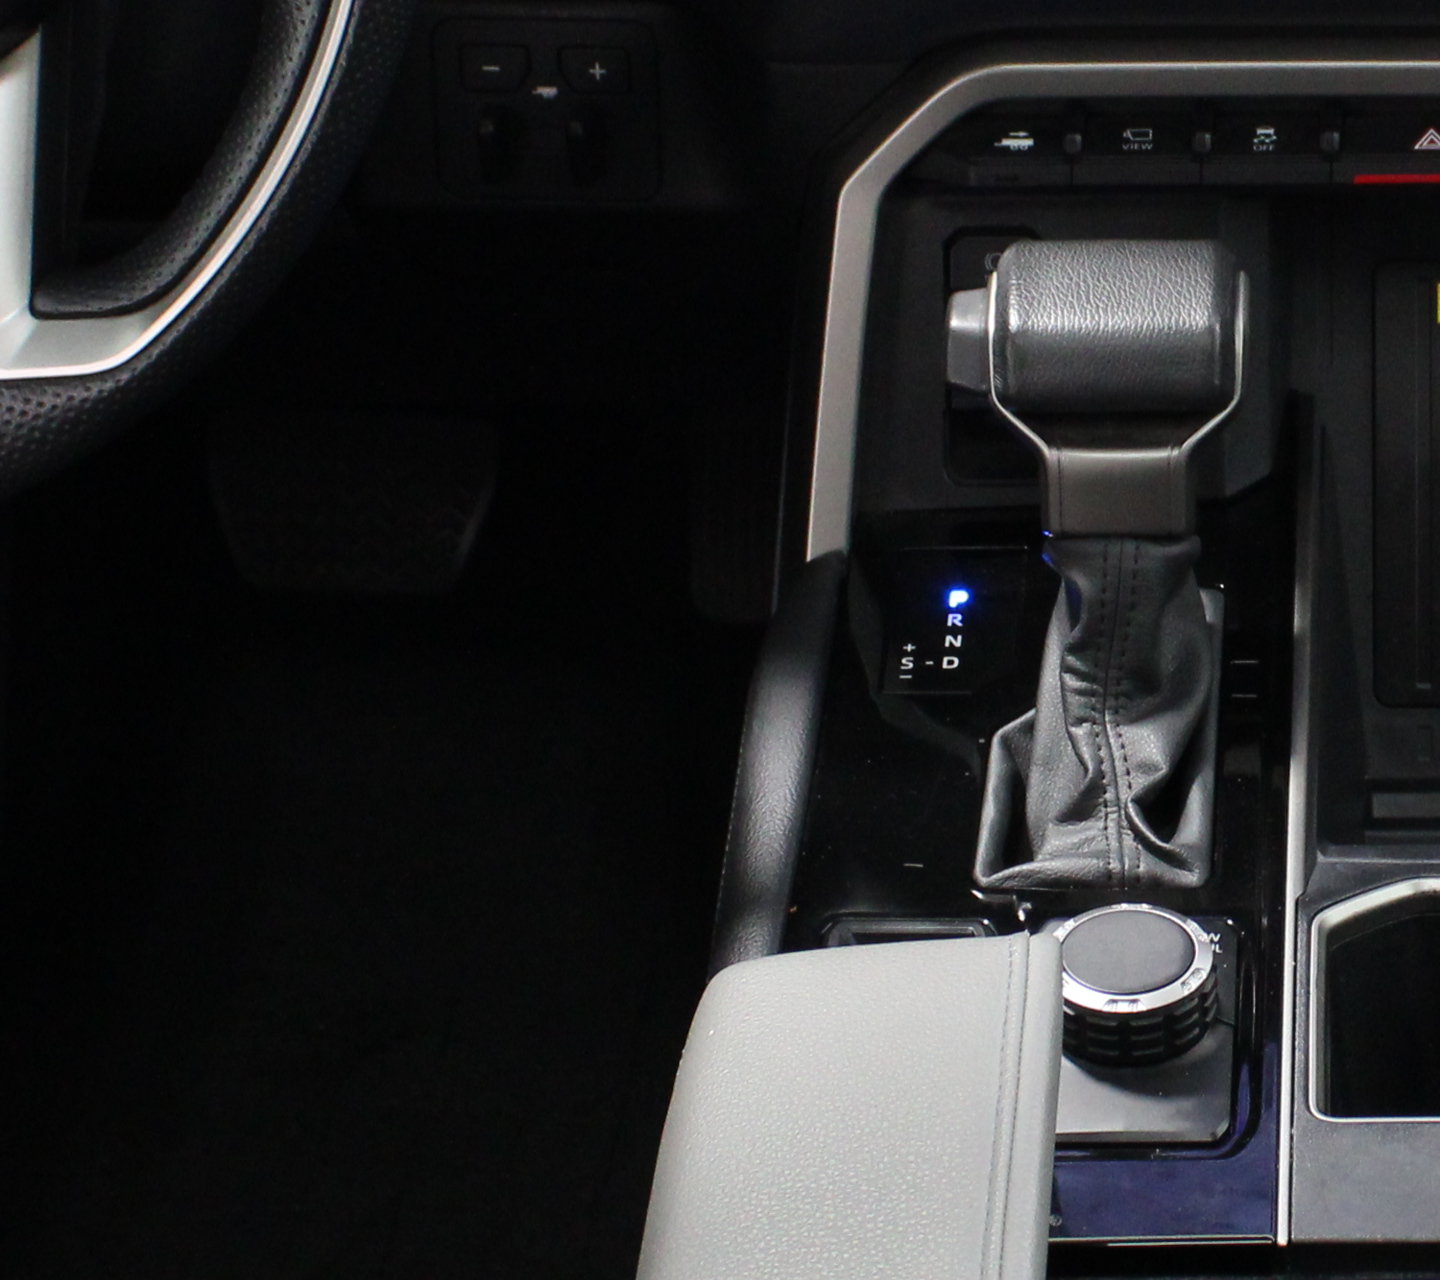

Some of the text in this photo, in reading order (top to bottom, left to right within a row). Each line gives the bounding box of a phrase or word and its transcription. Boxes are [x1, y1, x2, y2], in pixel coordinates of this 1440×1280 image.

[1122, 142, 1153, 151] VIEW
[1253, 144, 1275, 153] OFF
[948, 589, 970, 608] P
[947, 613, 964, 627] R
[945, 634, 963, 648] N
[900, 656, 960, 670] S D
